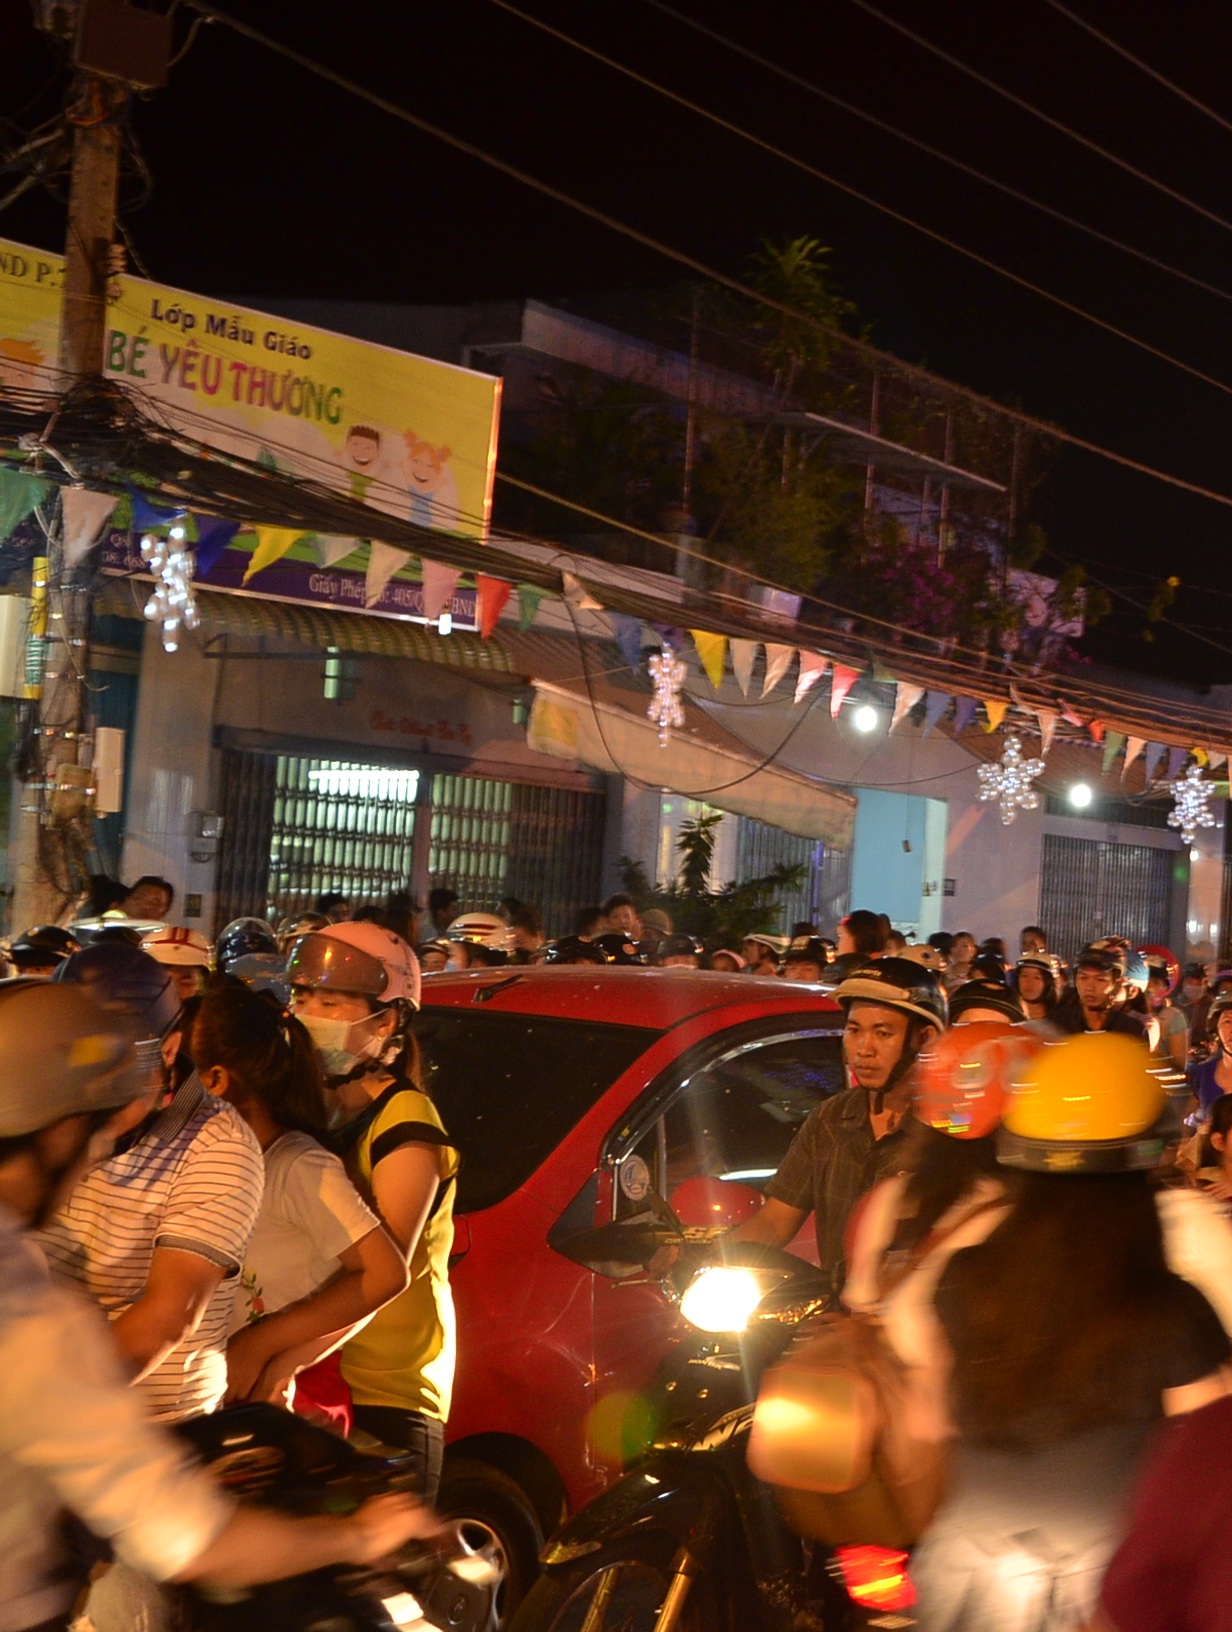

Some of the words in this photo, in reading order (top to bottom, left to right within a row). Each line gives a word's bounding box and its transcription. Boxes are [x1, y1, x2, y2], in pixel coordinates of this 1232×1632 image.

[151, 299, 196, 332] Lớp
[205, 314, 255, 345] Mẫu
[263, 331, 311, 360] Giáo
[105, 326, 149, 378] BÉ
[160, 339, 222, 396] YÊU
[230, 361, 343, 425] THƯƠNG
